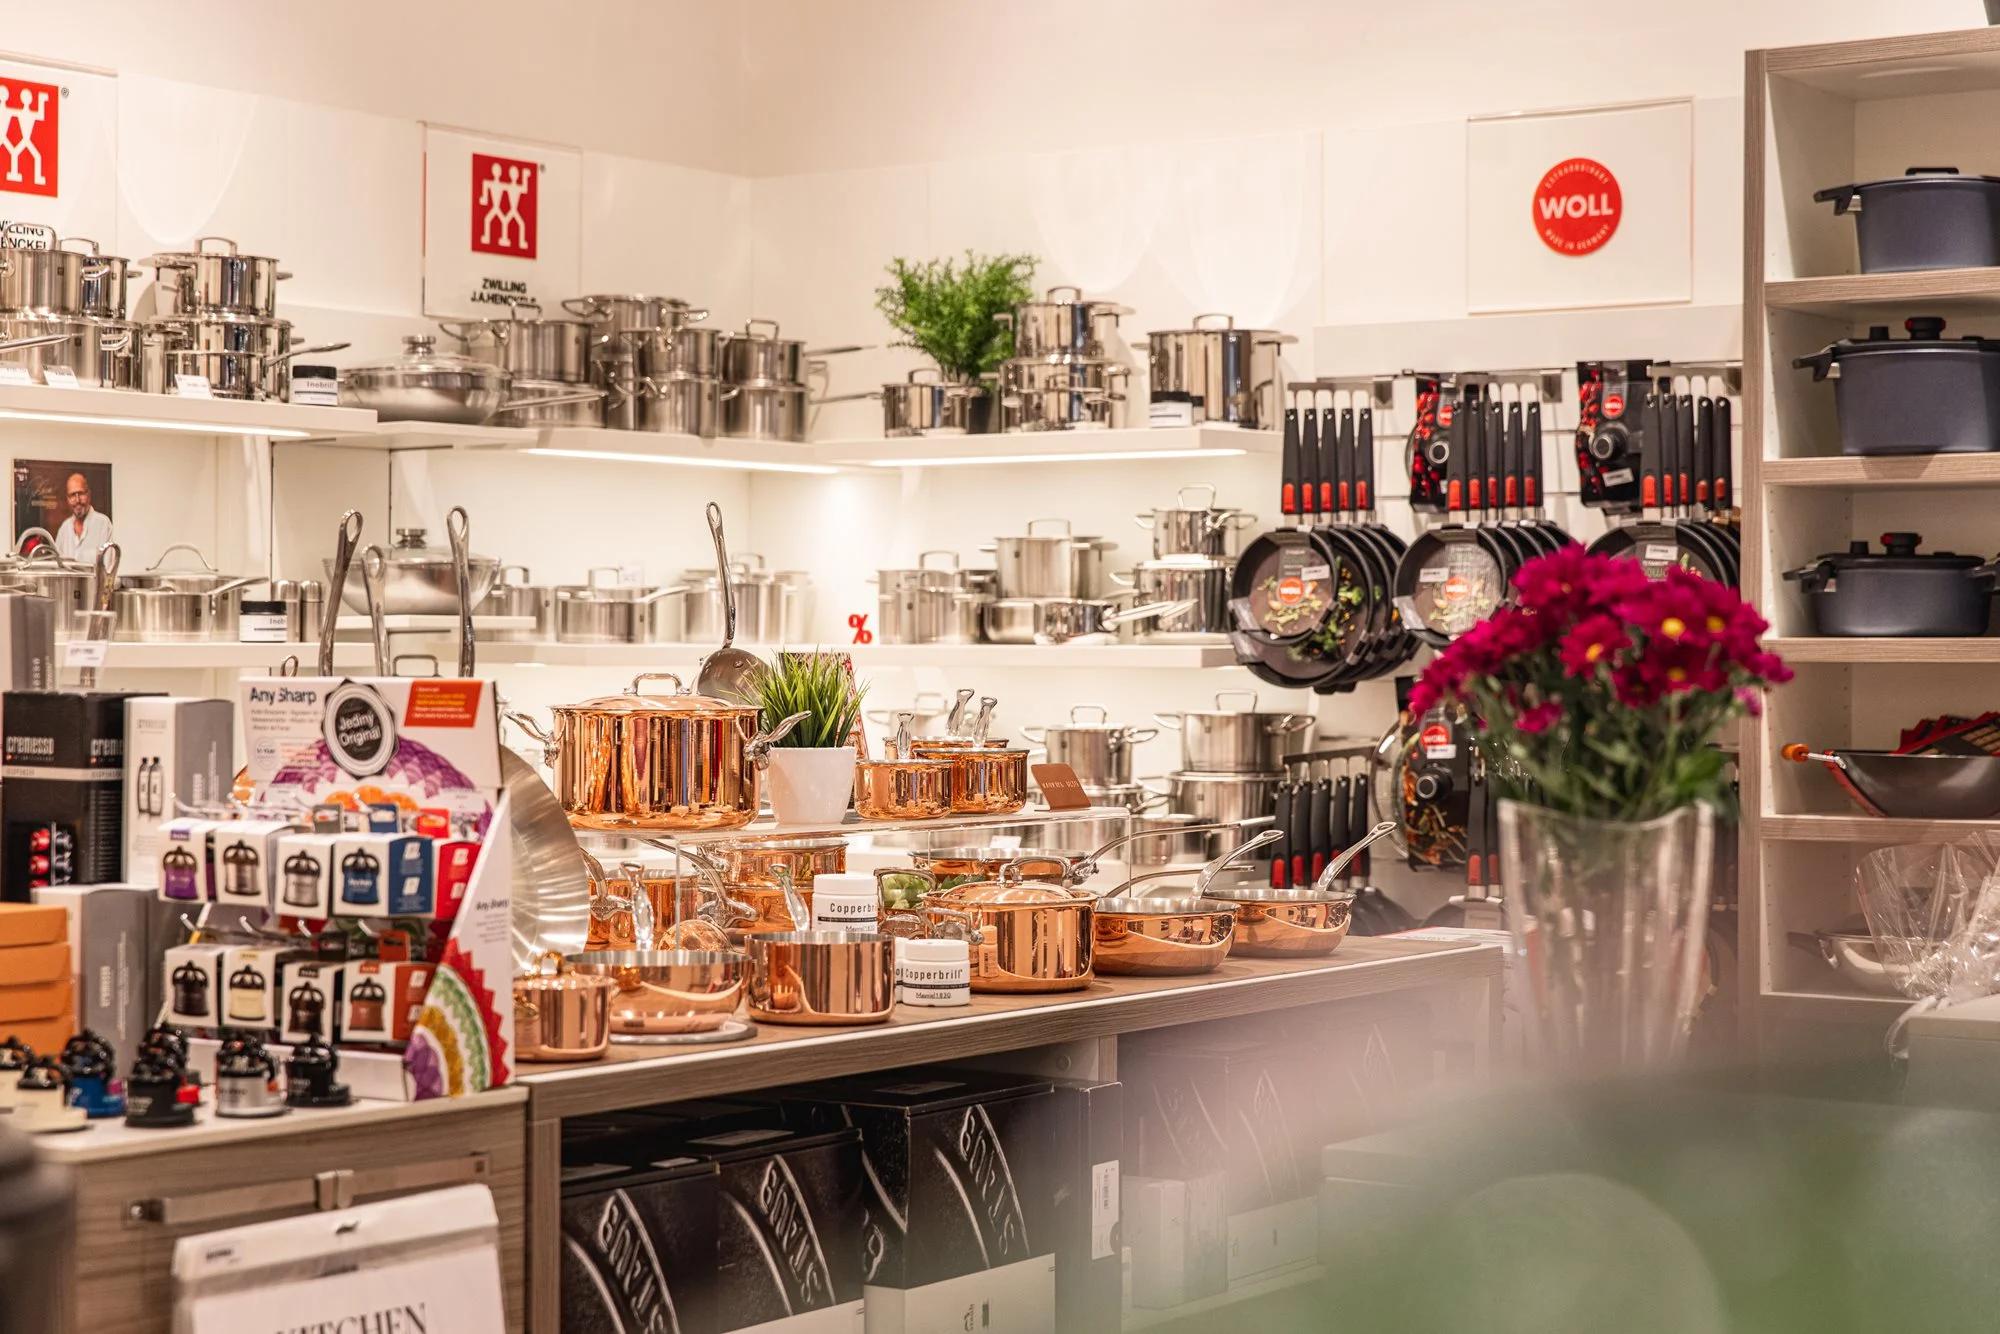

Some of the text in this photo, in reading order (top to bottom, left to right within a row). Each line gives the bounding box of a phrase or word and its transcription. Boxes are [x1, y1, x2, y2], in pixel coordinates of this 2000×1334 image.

[1538, 193, 1615, 220] WOLL
[482, 278, 527, 294] ZWILLING
[6, 736, 55, 755] cremesso
[905, 967, 963, 981] Copperbrill
